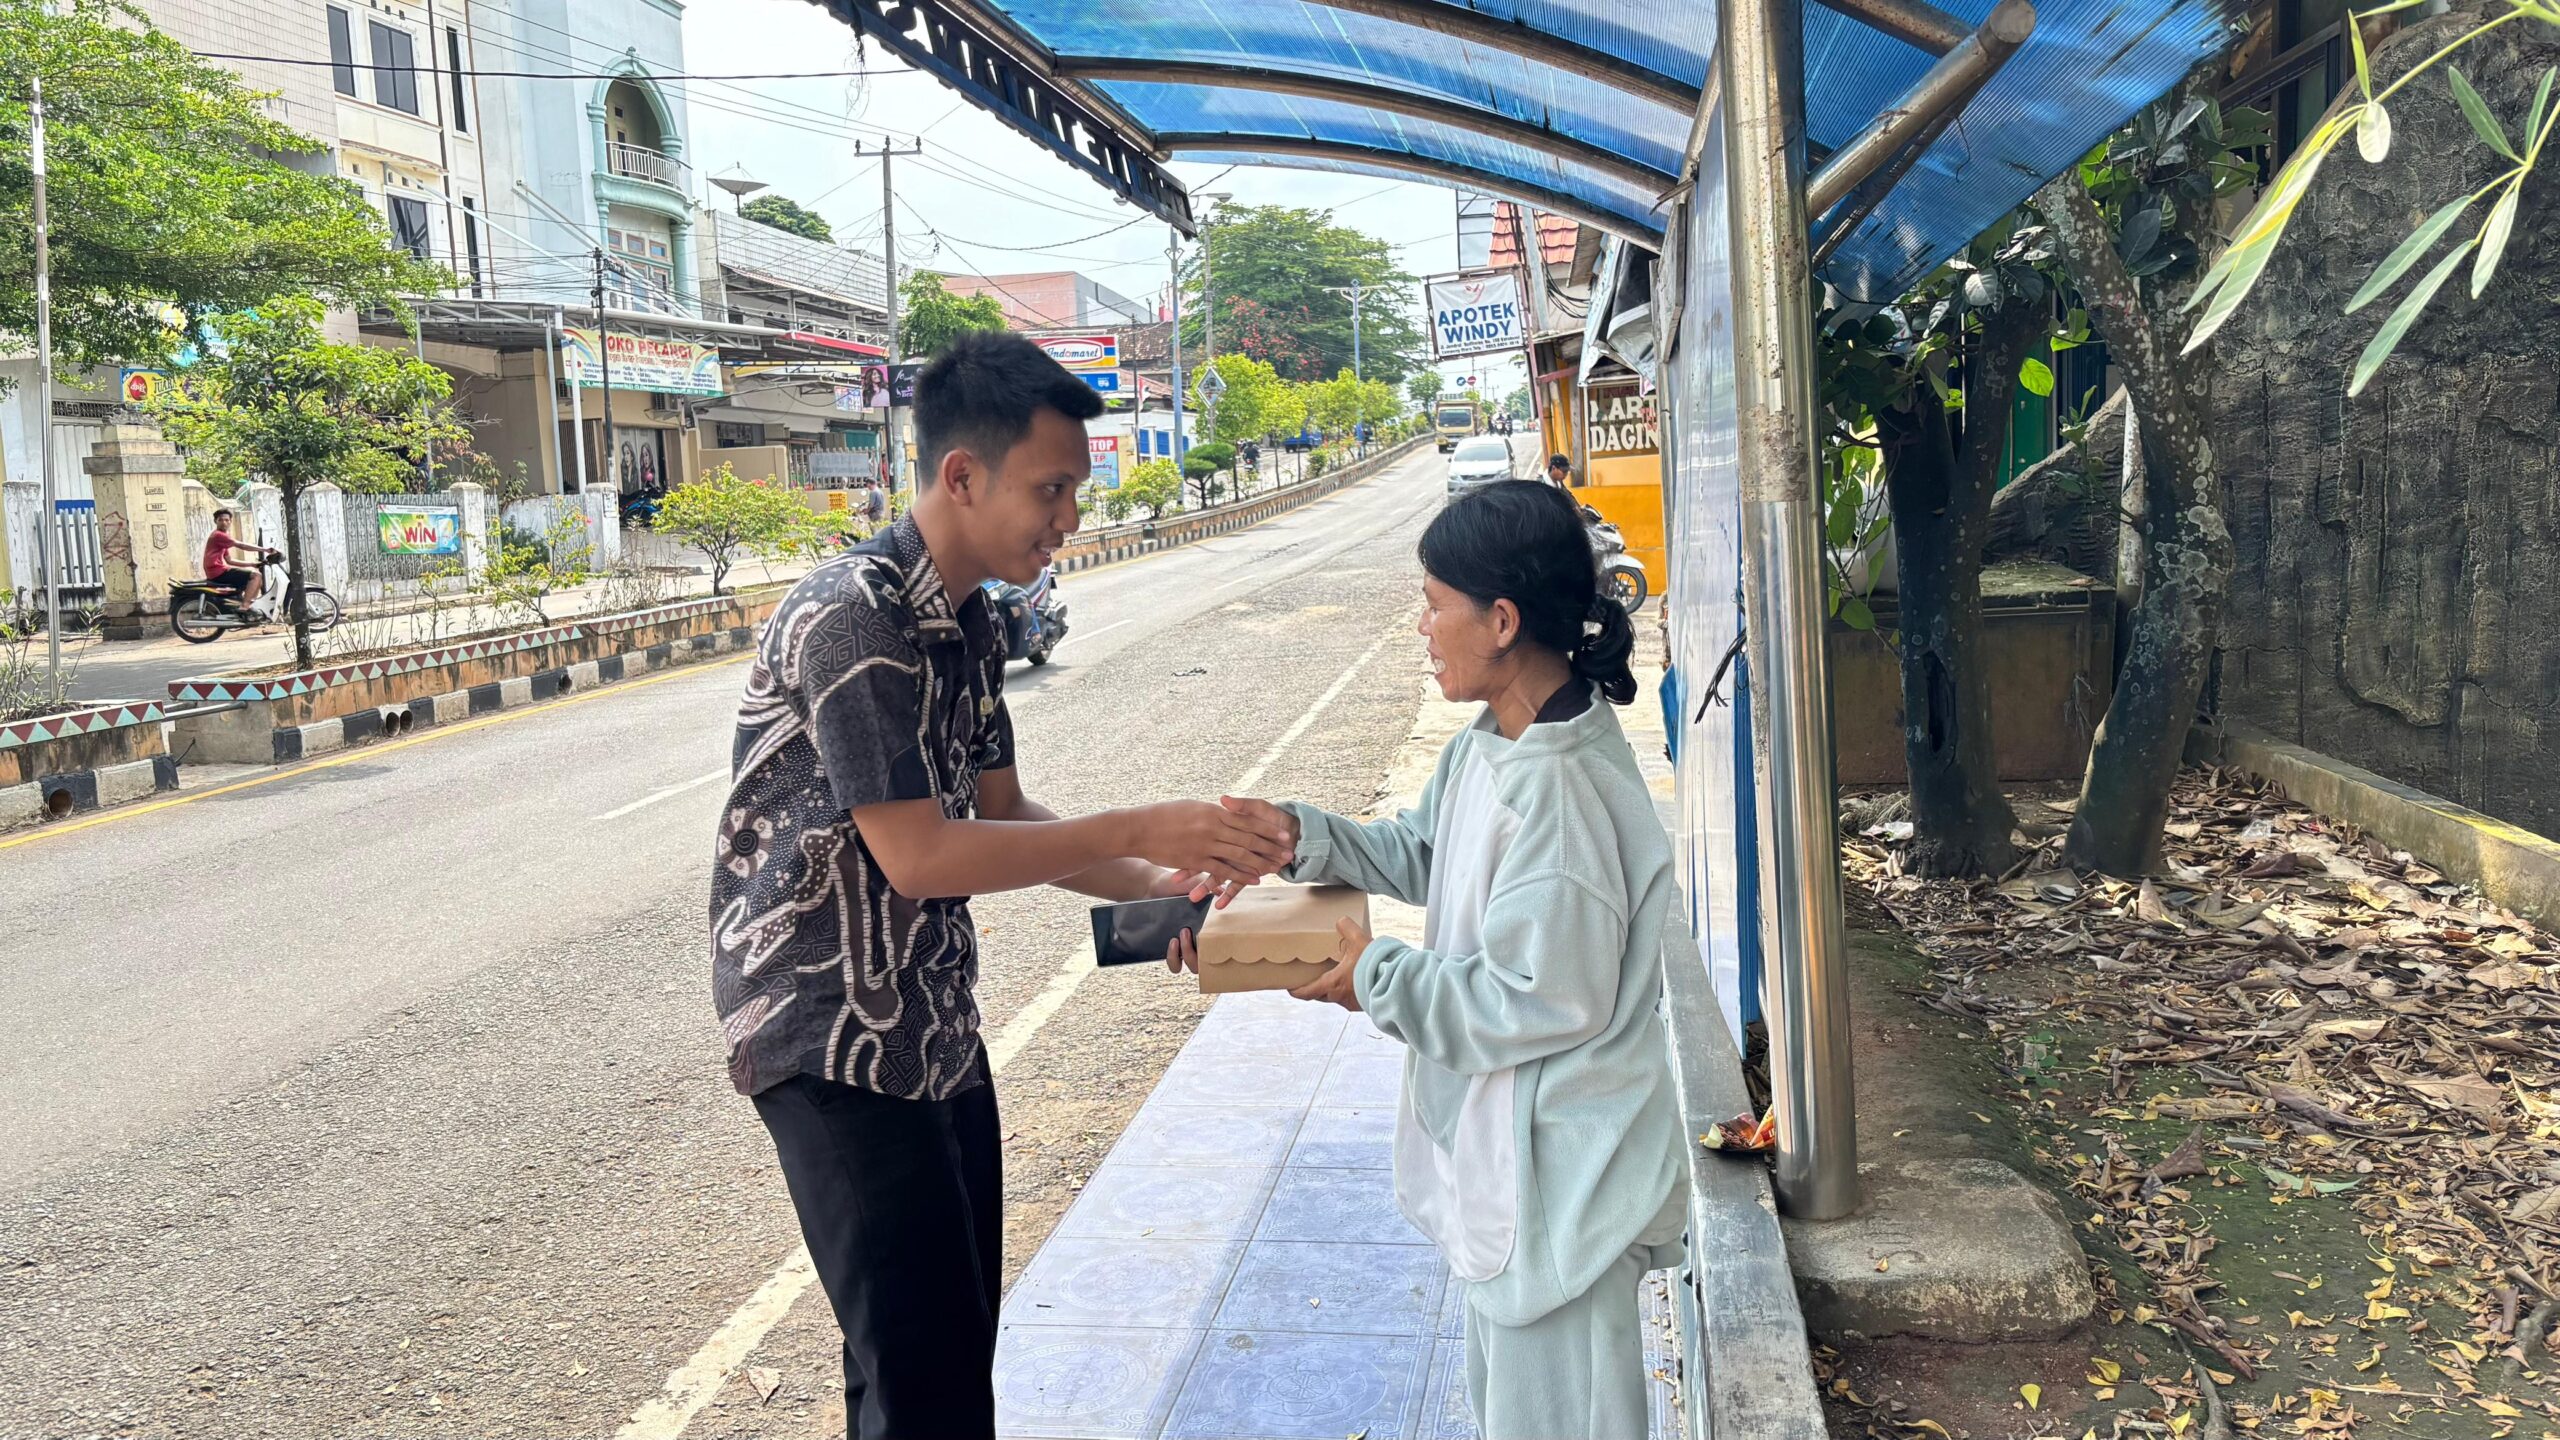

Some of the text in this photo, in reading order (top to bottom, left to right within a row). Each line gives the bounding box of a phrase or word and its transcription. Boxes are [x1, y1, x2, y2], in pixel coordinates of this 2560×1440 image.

[1438, 302, 1515, 327] APOTEK
[1444, 320, 1511, 343] WINDY
[598, 335, 693, 360] OKO PELANGI
[1047, 347, 1098, 358] Indomaret
